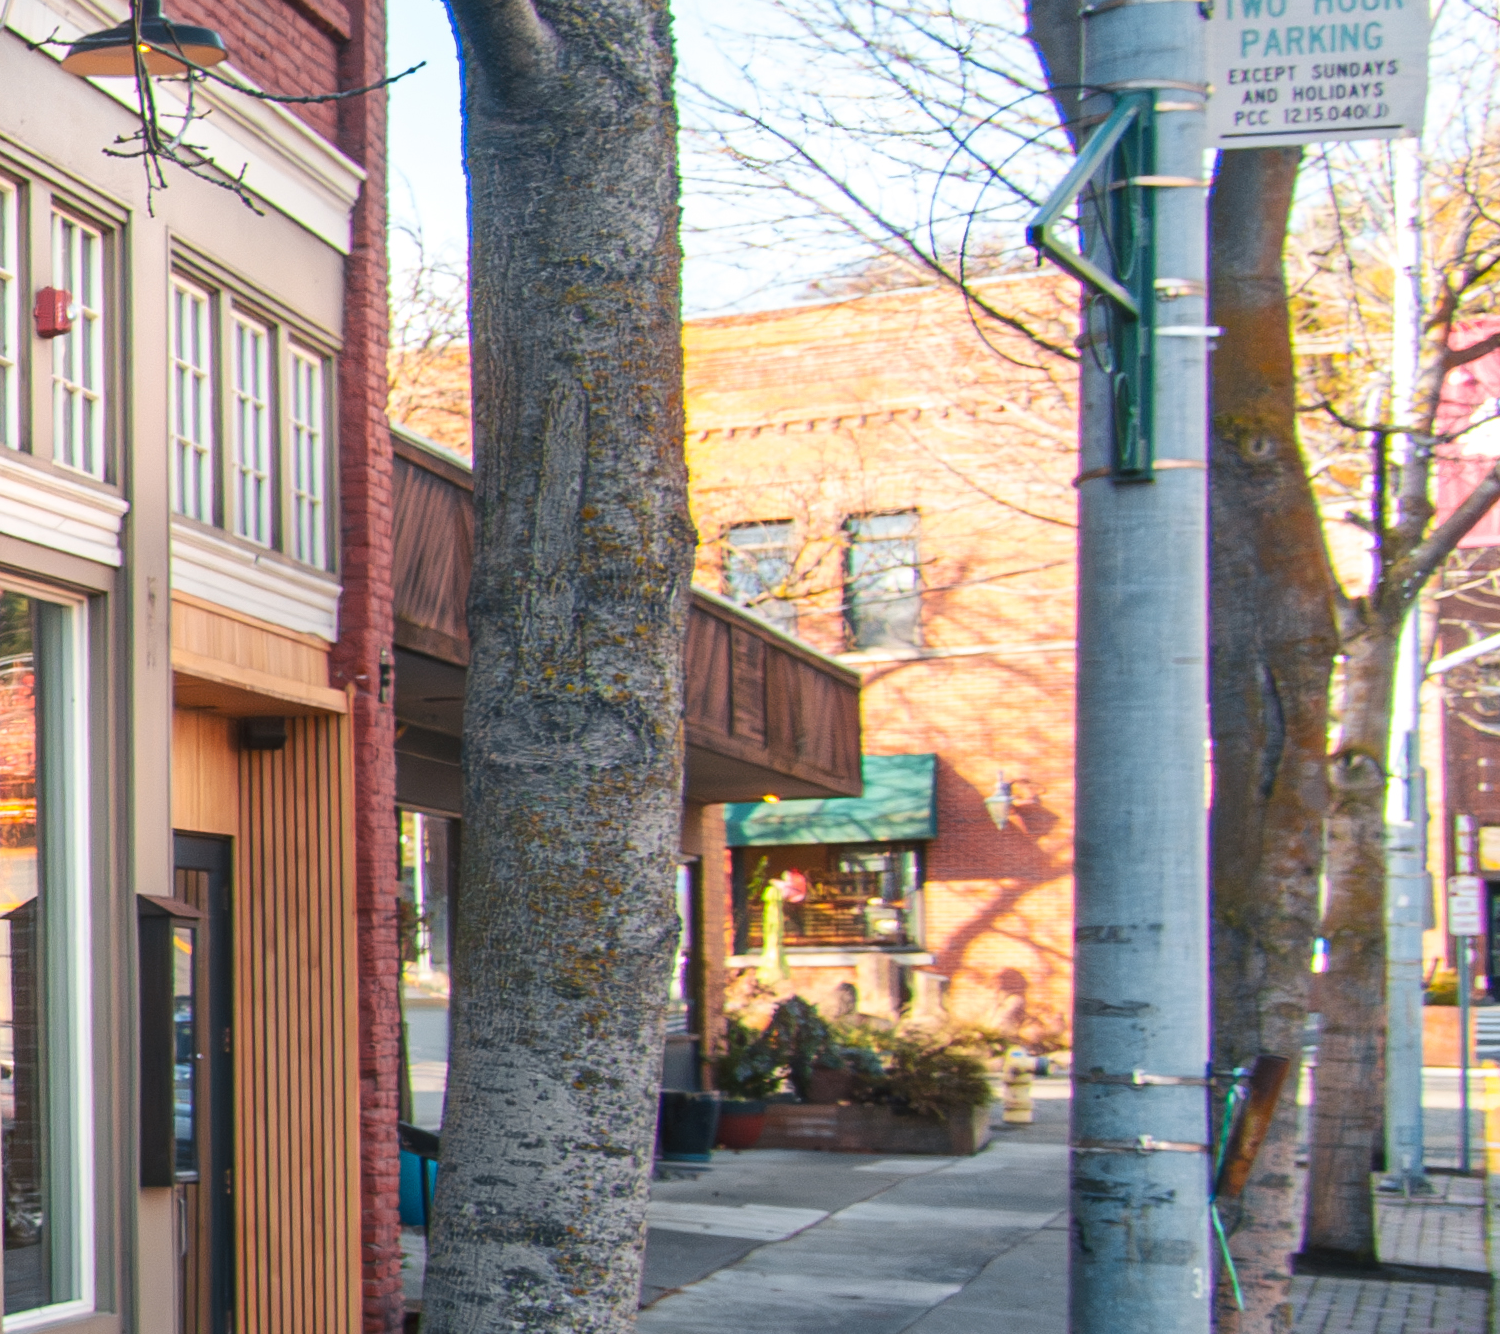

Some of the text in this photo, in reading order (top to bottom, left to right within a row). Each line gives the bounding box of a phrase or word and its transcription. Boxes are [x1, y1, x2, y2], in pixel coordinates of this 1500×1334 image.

[1241, 22, 1383, 58] PARKING
[1229, 59, 1399, 85] EXCEPT SUNDAYS
[1242, 82, 1384, 105] AND HOLIDAYS
[1234, 109, 1269, 127] PCC
